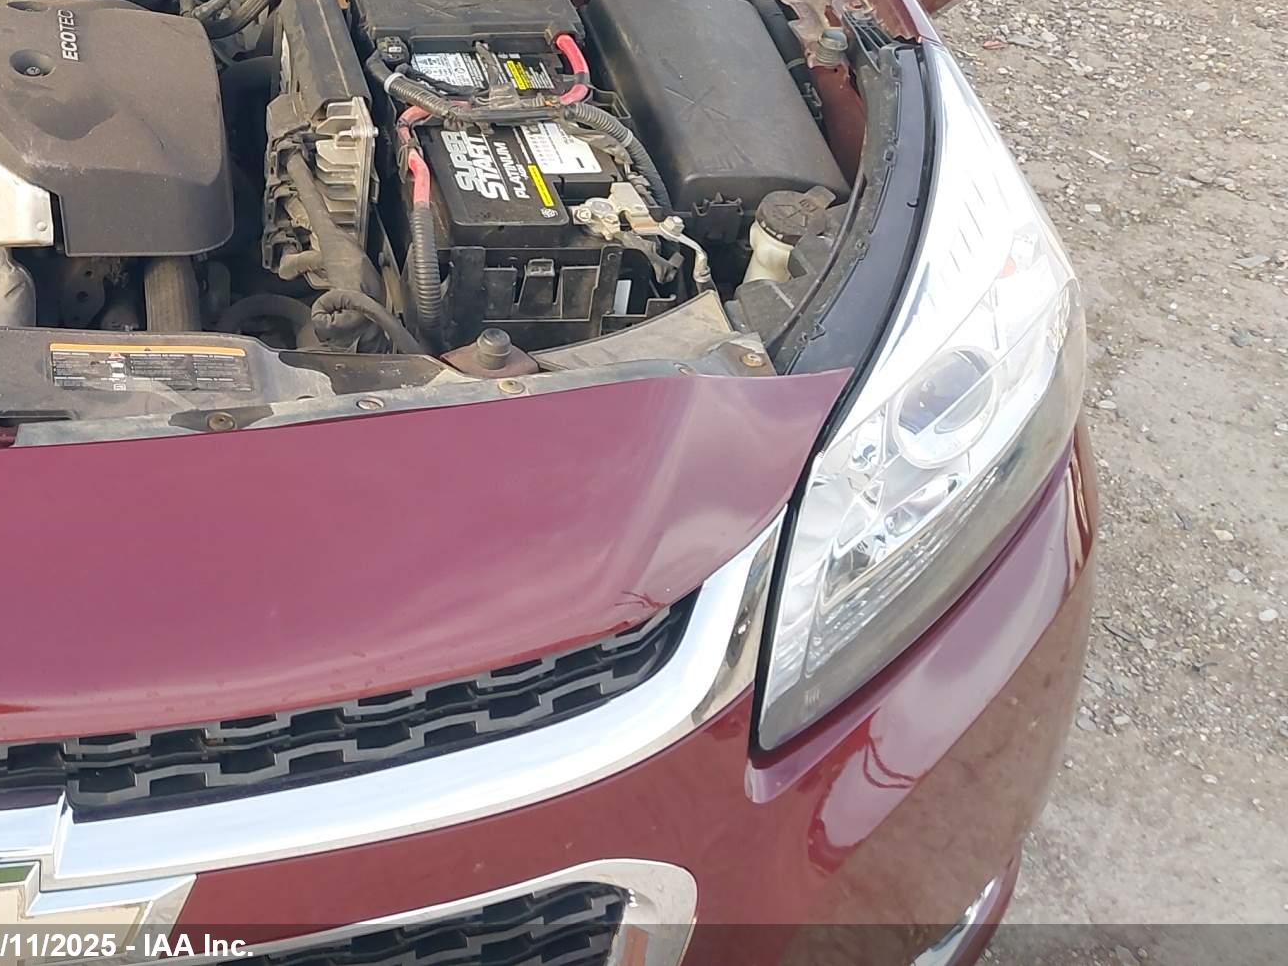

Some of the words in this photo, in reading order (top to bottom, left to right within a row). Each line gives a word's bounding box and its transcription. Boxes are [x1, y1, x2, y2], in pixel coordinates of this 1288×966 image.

[58, 9, 79, 61] ECOTEC
[441, 130, 476, 192] SUPER
[466, 134, 511, 201] START
[493, 141, 530, 199] PLATINUM
